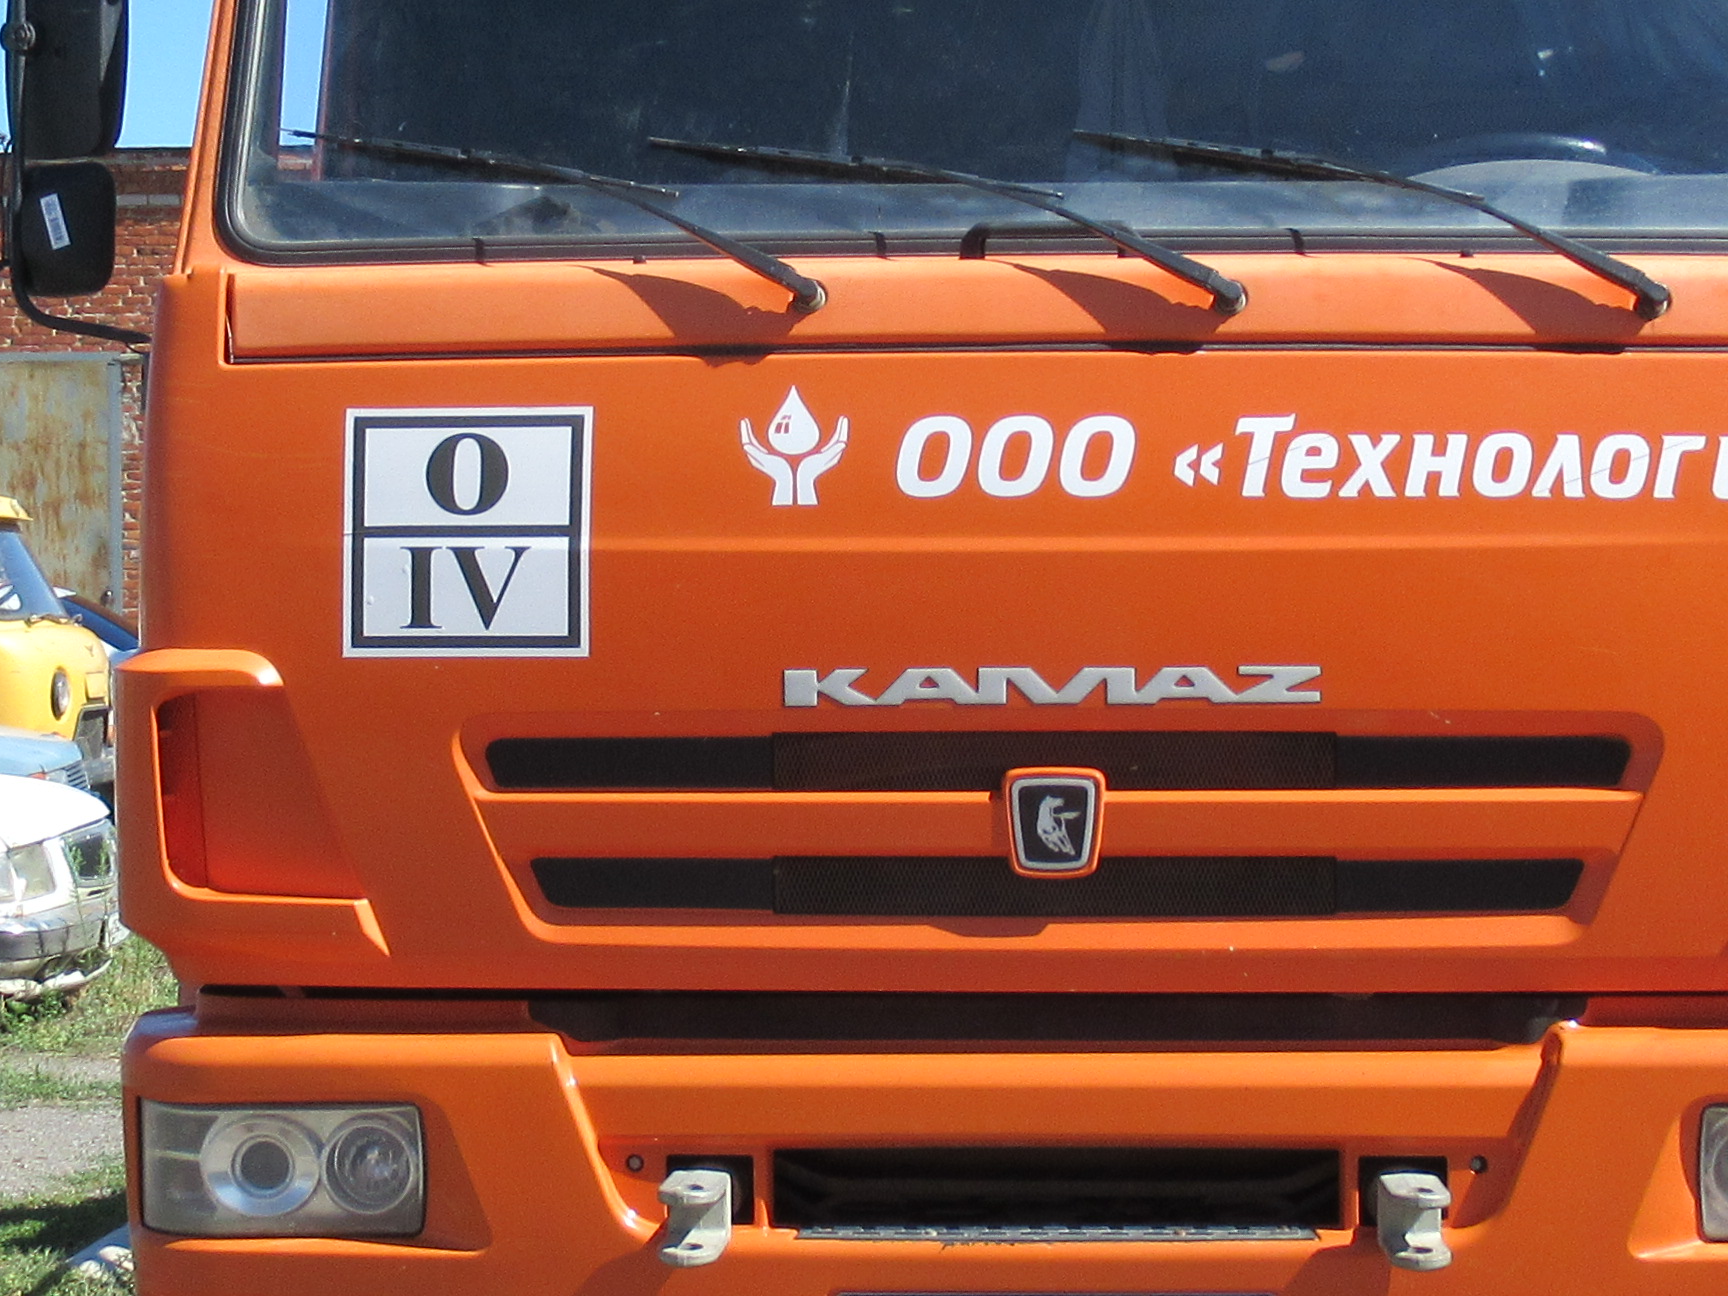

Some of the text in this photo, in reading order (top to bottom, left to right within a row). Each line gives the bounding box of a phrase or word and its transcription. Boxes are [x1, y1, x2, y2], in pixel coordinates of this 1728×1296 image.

[896, 413, 1136, 498] ООО
[399, 545, 532, 631] IV
[783, 665, 1322, 707] KAMAZ
